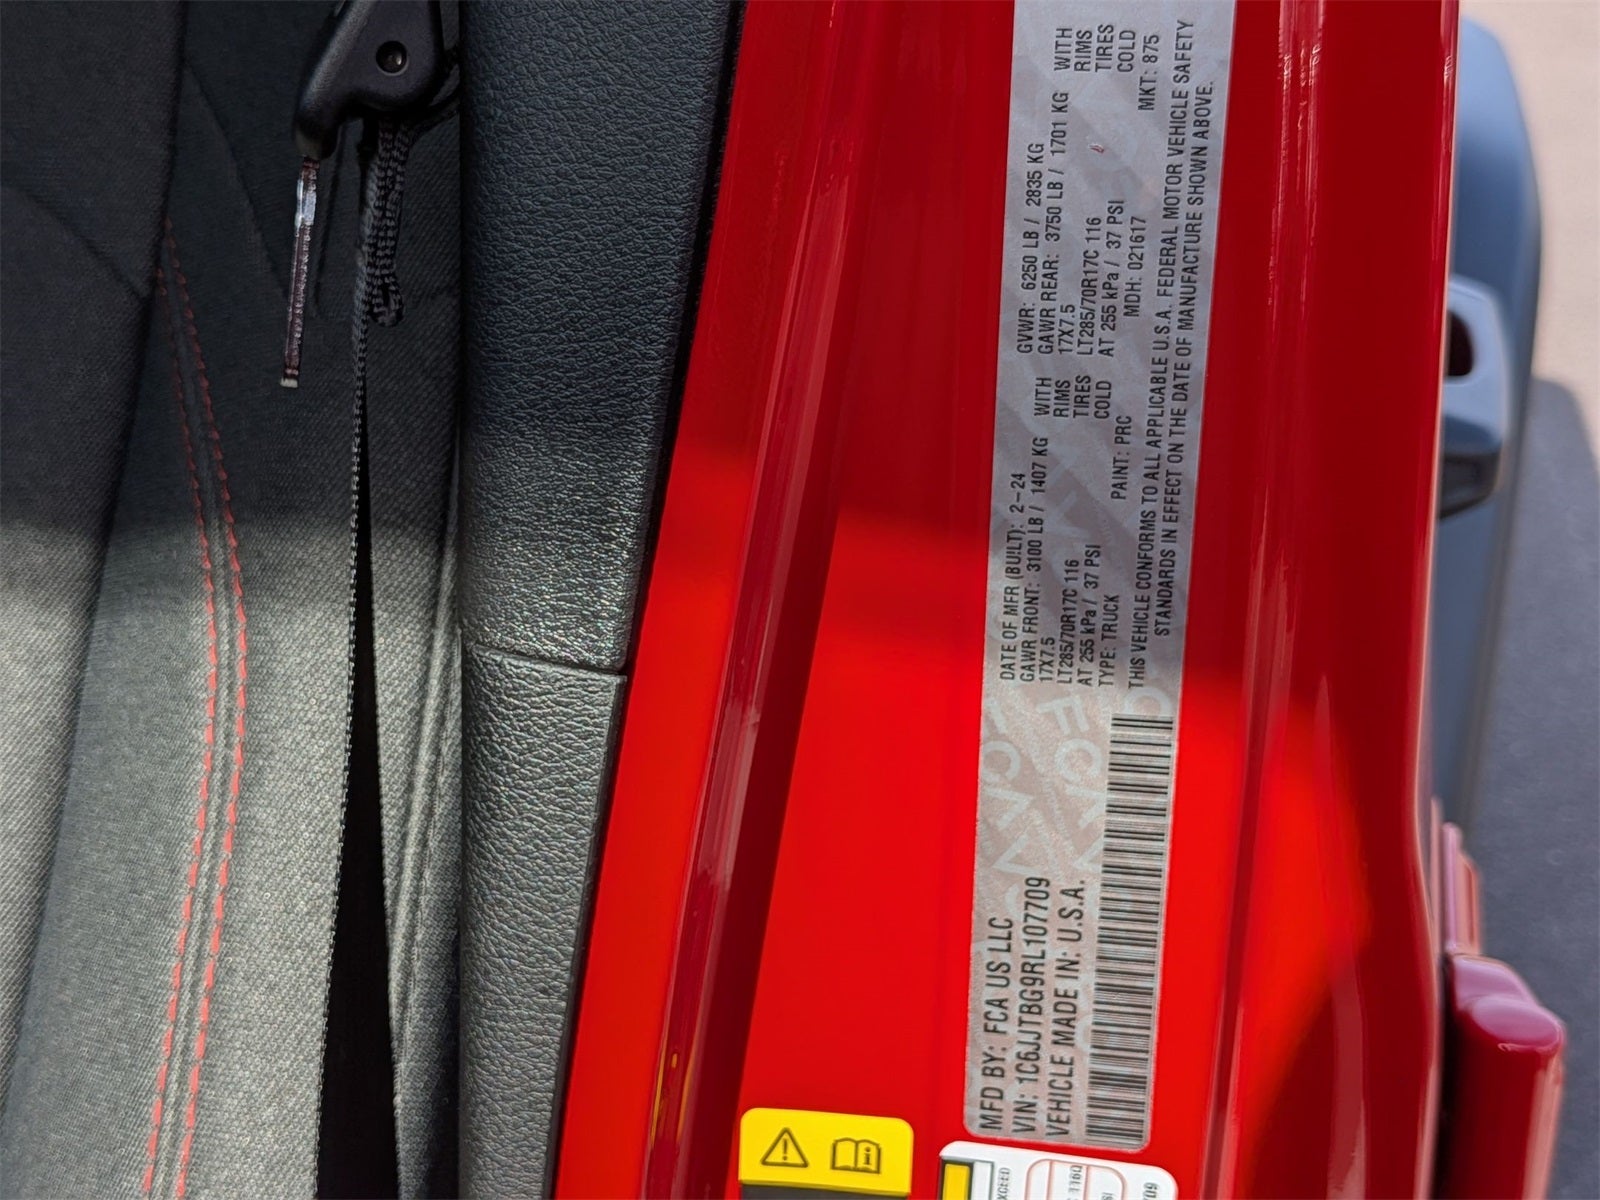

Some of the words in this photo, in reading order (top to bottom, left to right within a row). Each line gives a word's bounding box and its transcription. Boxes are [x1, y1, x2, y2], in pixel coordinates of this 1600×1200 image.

[1053, 27, 1073, 72] WITH
[1073, 29, 1093, 72] RIMS
[1094, 23, 1115, 73] TIRES
[1116, 29, 1137, 73] COLD
[1141, 34, 1160, 64] 875
[1172, 19, 1194, 84] SAFETY
[1050, 91, 1070, 114] KG
[1137, 70, 1158, 111] MKT:
[1166, 89, 1190, 158] VEHICLE
[1191, 81, 1214, 141] ABOVE.
[1026, 143, 1045, 164] KG
[1049, 121, 1067, 157] 1701
[1025, 169, 1044, 207] 2835
[1046, 181, 1064, 200] LB
[1162, 163, 1184, 220] MOTOR
[1186, 145, 1209, 206] SHOWN
[1044, 206, 1063, 242] 3750
[1084, 217, 1102, 244] 116
[1106, 200, 1125, 225] PSI
[1021, 230, 1040, 249] LB
[1105, 230, 1123, 250] 37
[1127, 215, 1147, 271] 021617
[1020, 255, 1038, 291] 6250
[1040, 254, 1060, 302] REAR:
[1156, 225, 1179, 298] FEDERAL
[1176, 211, 1203, 331] MANUFACTURE
[1076, 249, 1100, 356] LT285/70R17C
[1101, 272, 1120, 300] kPa
[1122, 277, 1142, 318] MDH:
[1016, 302, 1036, 354] GVWR:
[1037, 307, 1057, 355] GAWR
[1057, 304, 1076, 355] 17X7.5
[1099, 304, 1118, 332] 255
[1152, 304, 1173, 351] U.S.A.
[1097, 337, 1115, 358] AT
[1175, 337, 1193, 357] OF
[1033, 377, 1052, 417] WITH
[1052, 379, 1071, 418] RIMS
[1072, 374, 1092, 419] TIRES
[1093, 380, 1112, 420] COLD
[1171, 362, 1191, 402] DATE
[1145, 357, 1169, 449] APPLICABLE
[1168, 407, 1188, 438] THE
[1031, 436, 1049, 457] KG
[1114, 415, 1133, 445] PRC
[1142, 453, 1162, 481] ALL
[1166, 442, 1185, 464] ON
[1008, 473, 1026, 514] 2-24
[1030, 461, 1047, 495] 1407
[1110, 451, 1130, 500] PAINT:
[1140, 485, 1159, 505] TO
[1162, 468, 1183, 523] EFFECT
[1027, 516, 1045, 534] LB
[1160, 528, 1178, 544] IN
[1004, 524, 1027, 580] (BUILT):
[1025, 539, 1043, 572] 3100
[1083, 544, 1101, 568] PSI
[1135, 509, 1157, 590] CONFORMS
[1063, 559, 1080, 583] 116
[1083, 572, 1099, 590] 37
[1002, 585, 1020, 617] MFR
[1021, 583, 1040, 635] FRONT:
[1153, 548, 1176, 637] STANDARDS
[1001, 621, 1018, 640] OF
[1056, 588, 1078, 685] LT285/70R17C
[1079, 609, 1097, 635] kPa
[1100, 594, 1120, 641] TRUCK
[1130, 594, 1151, 653] VEHICLE
[999, 644, 1018, 681] DATE
[1019, 639, 1038, 683] GAWR
[1038, 636, 1056, 683] 17X7.5
[1078, 638, 1095, 663] 255
[1097, 647, 1116, 688] TYPE:
[1076, 667, 1093, 687] AT
[1127, 657, 1146, 689] THIS
[1056, 879, 1086, 943] U.S.A.
[986, 916, 1015, 954] LLC
[985, 960, 1012, 989] US
[1014, 876, 1051, 1085] 1C6JJTBG9RL107709
[1054, 951, 1082, 981] IN:
[983, 997, 1010, 1036] FCA
[1050, 987, 1079, 1048] MADE
[981, 1045, 1007, 1079] BY:
[978, 1086, 1005, 1131] MFD
[1011, 1093, 1039, 1134] VIN:
[1045, 1054, 1075, 1137] VEHICLE
